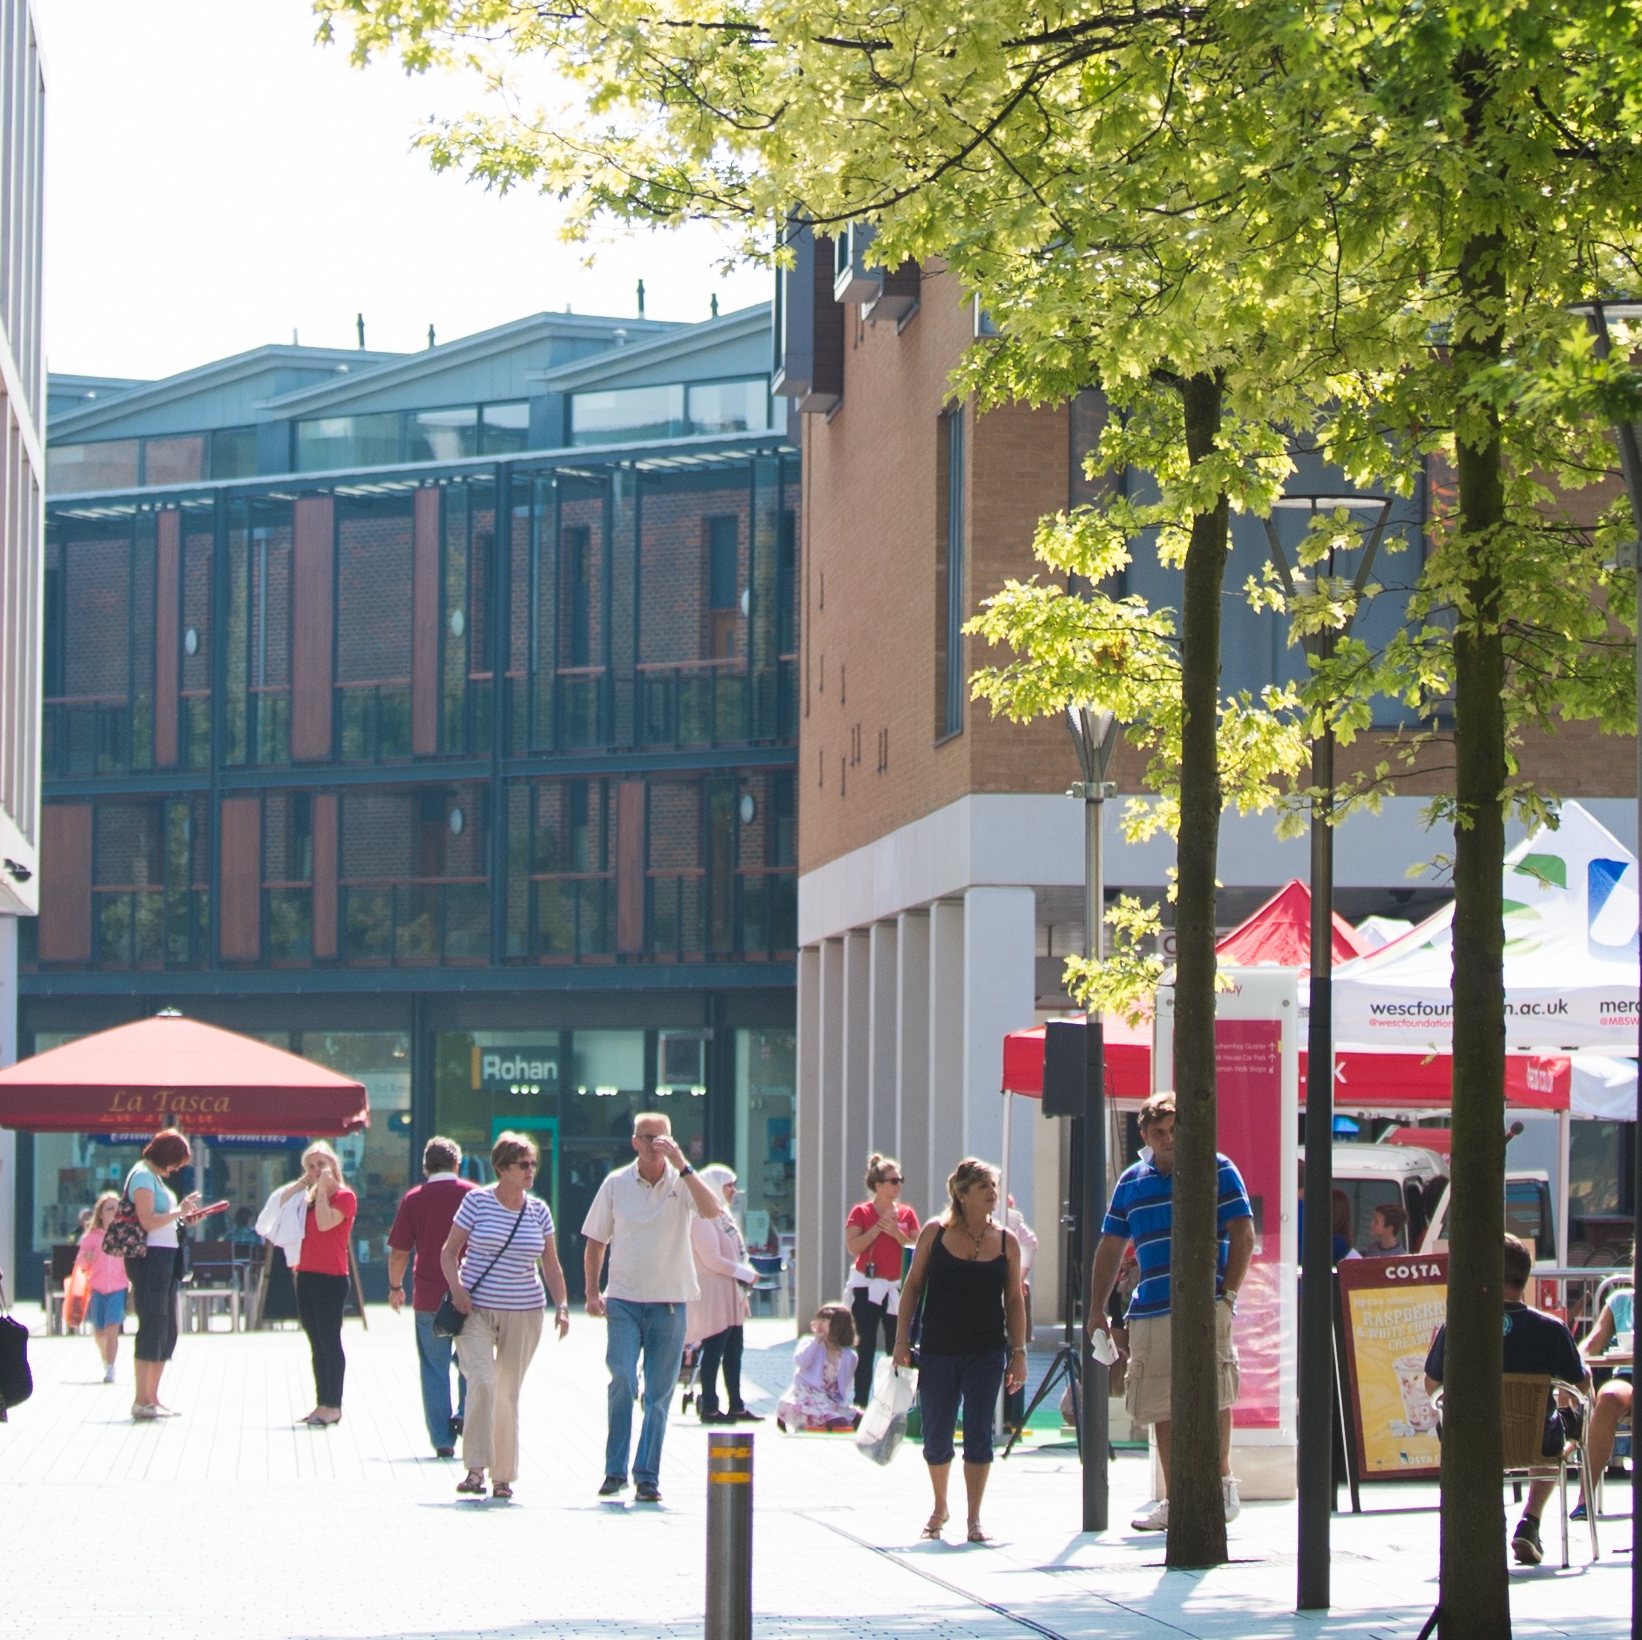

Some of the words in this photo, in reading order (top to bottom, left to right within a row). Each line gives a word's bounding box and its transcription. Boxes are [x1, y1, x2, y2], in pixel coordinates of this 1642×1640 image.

[481, 1053, 558, 1081] Rohan
[109, 1090, 143, 1112] La
[152, 1089, 231, 1113] Tasca
[1385, 1264, 1442, 1280] COSTA
[1362, 1300, 1446, 1327] RASPBERR
[1368, 1324, 1405, 1339] WHITE
